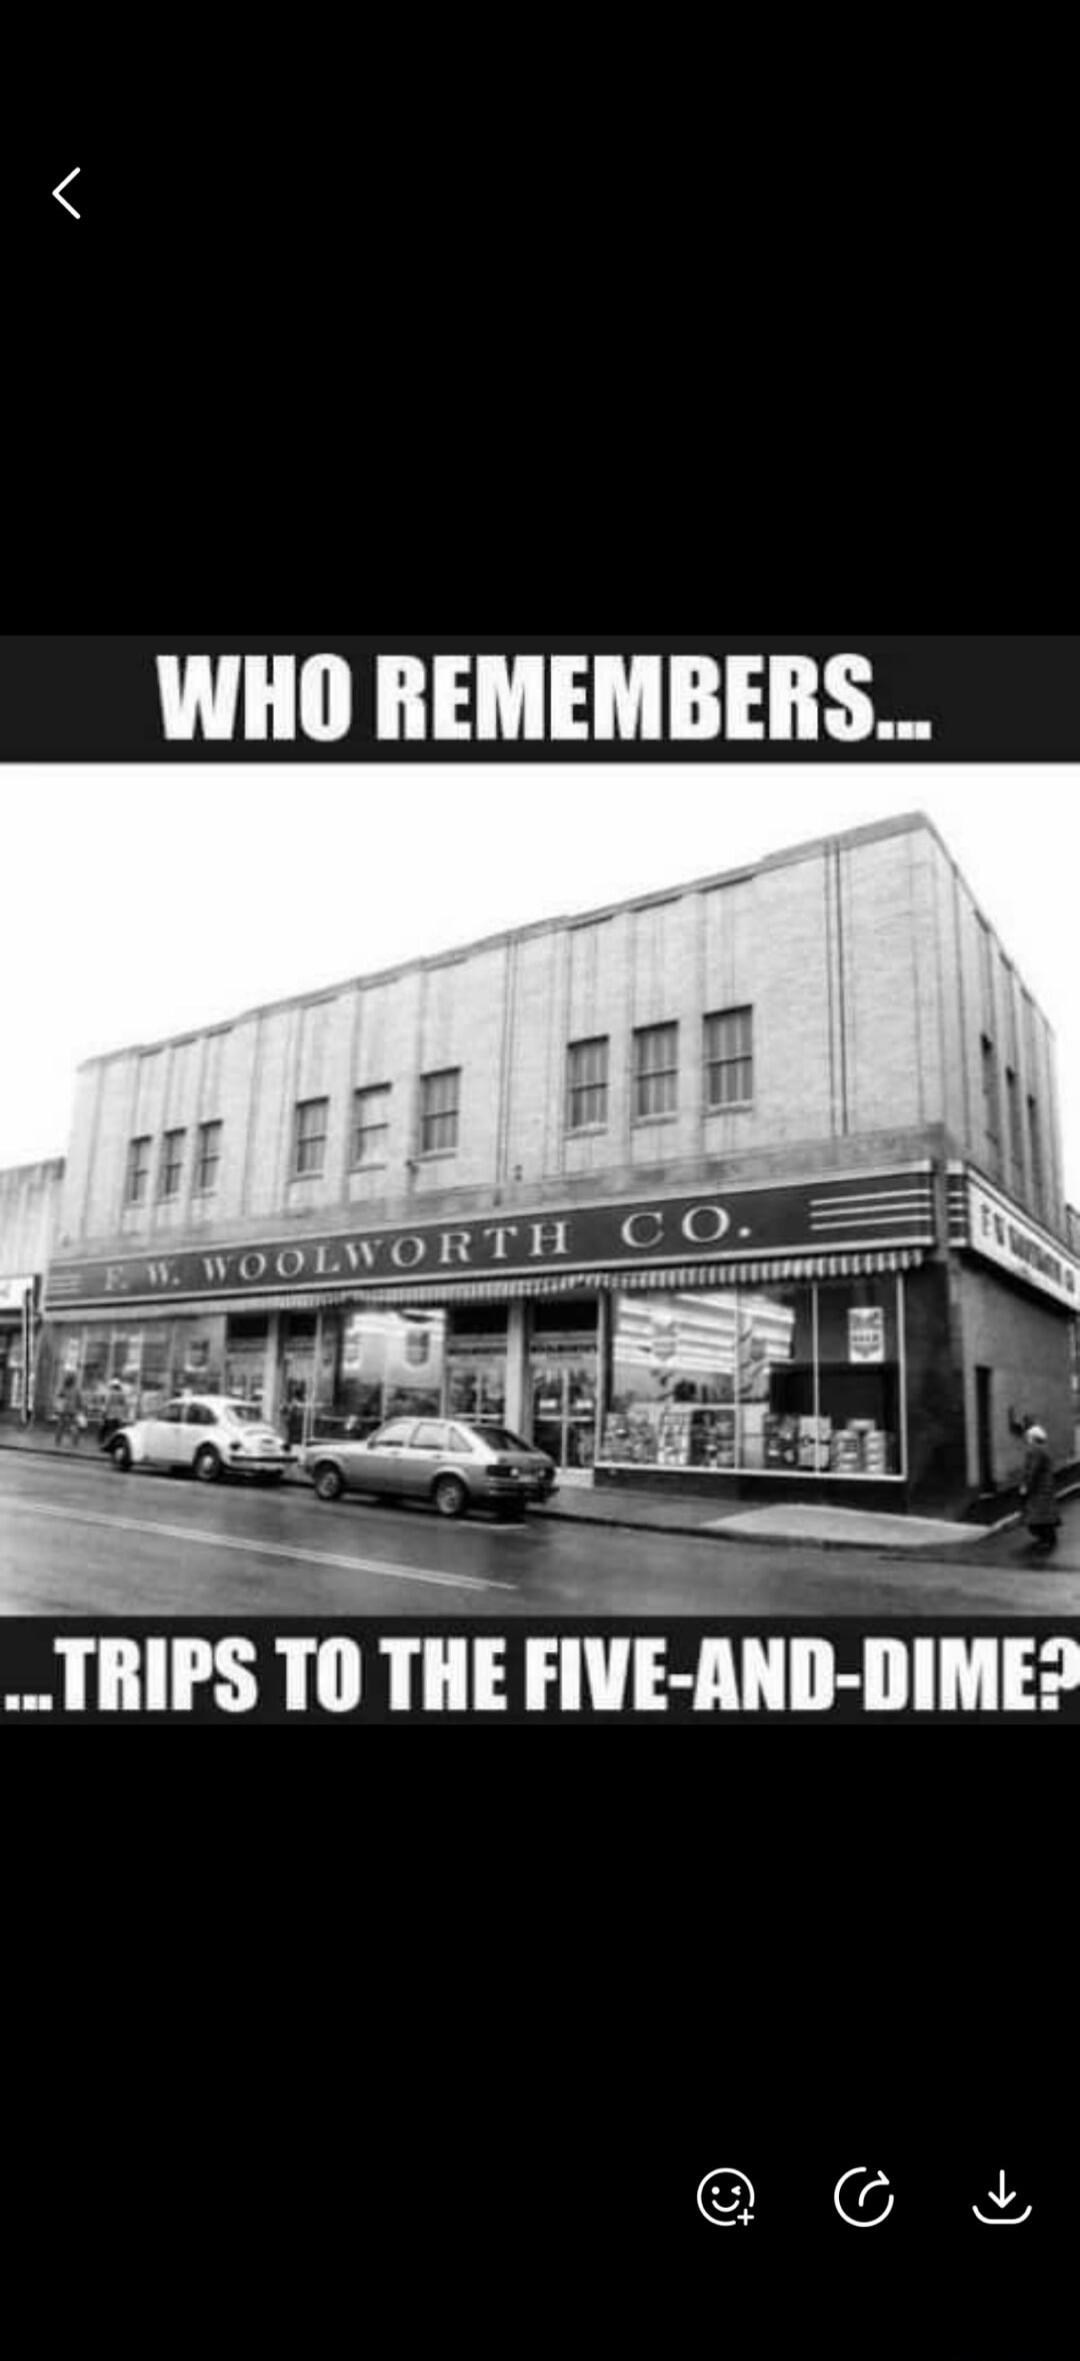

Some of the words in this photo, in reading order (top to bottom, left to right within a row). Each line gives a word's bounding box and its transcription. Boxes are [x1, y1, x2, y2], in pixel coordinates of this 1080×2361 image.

[104, 1265, 129, 1292] F.
[149, 1259, 181, 1287] W.
[203, 1220, 572, 1282] WOOLWORTH
[620, 1204, 752, 1248] CO.
